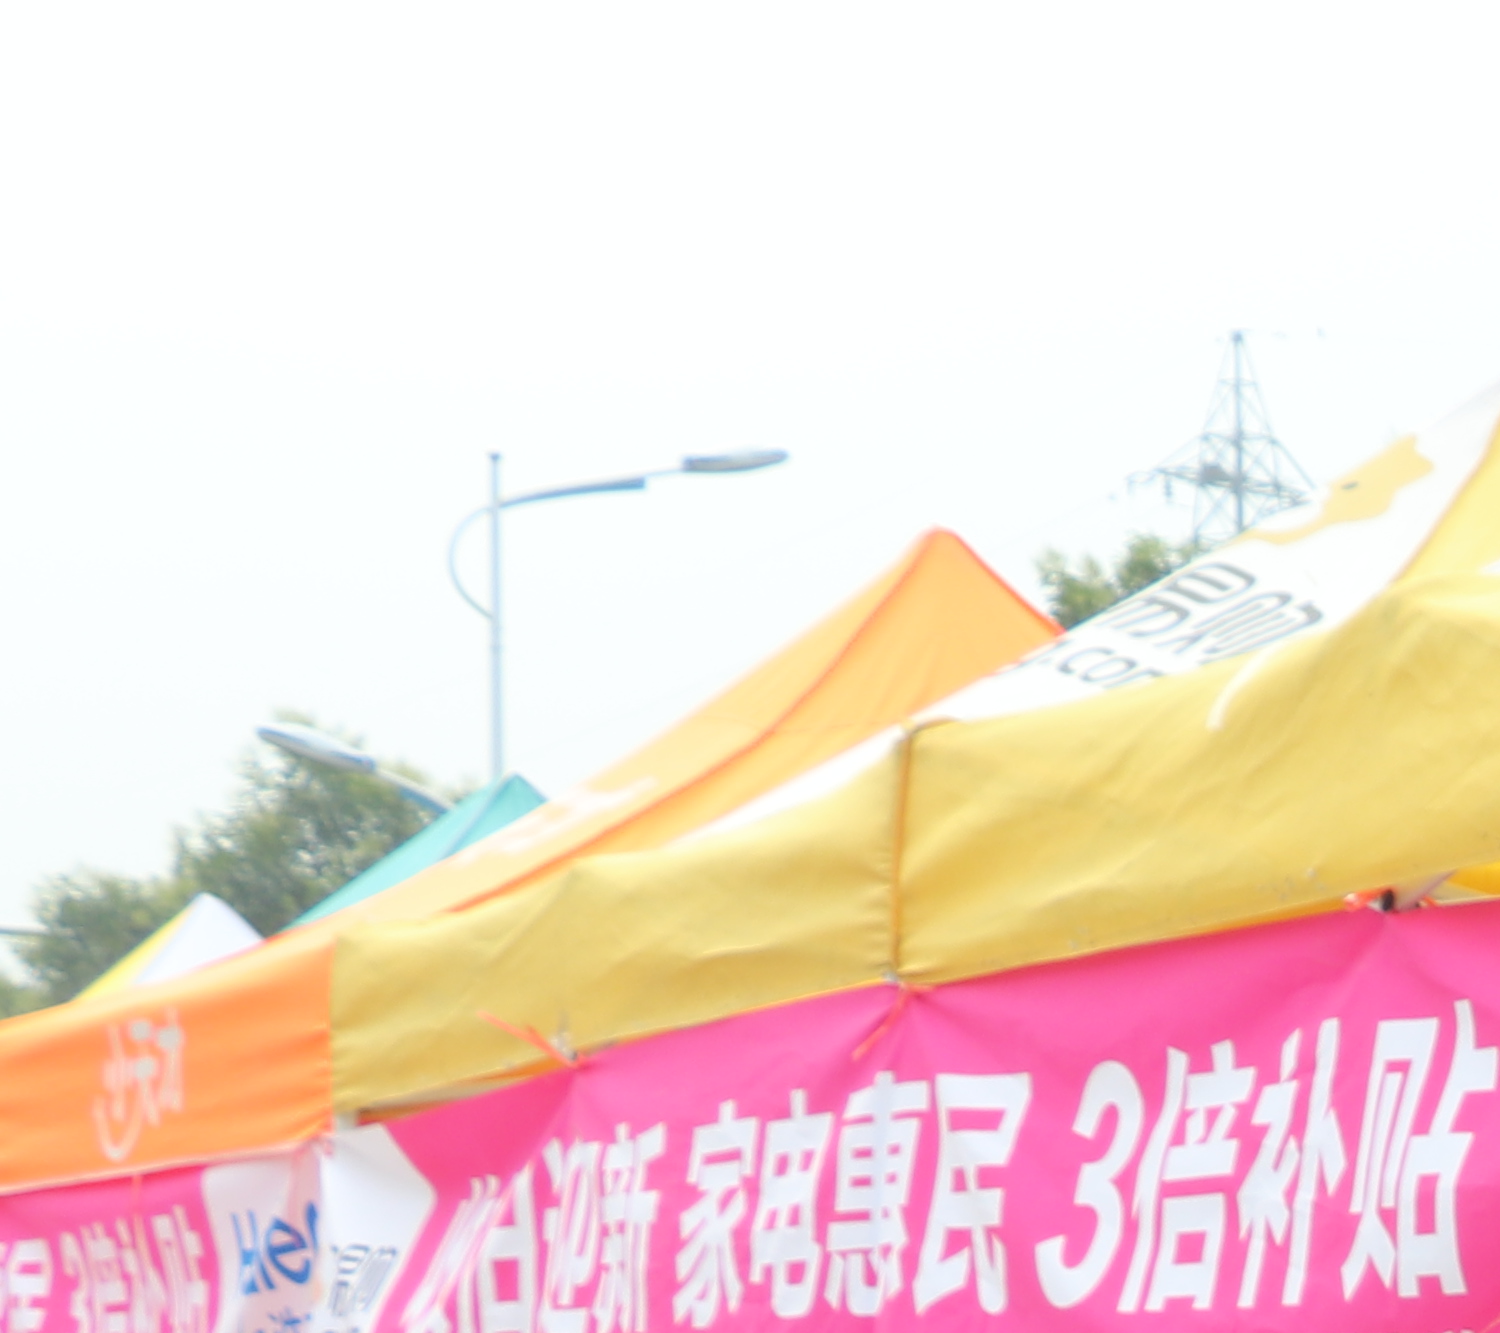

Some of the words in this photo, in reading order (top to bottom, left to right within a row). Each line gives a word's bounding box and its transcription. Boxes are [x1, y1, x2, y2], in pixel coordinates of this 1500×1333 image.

[672, 1068, 1033, 1330] 家电惠民
[1034, 1000, 1499, 1314] 3倍补贴
